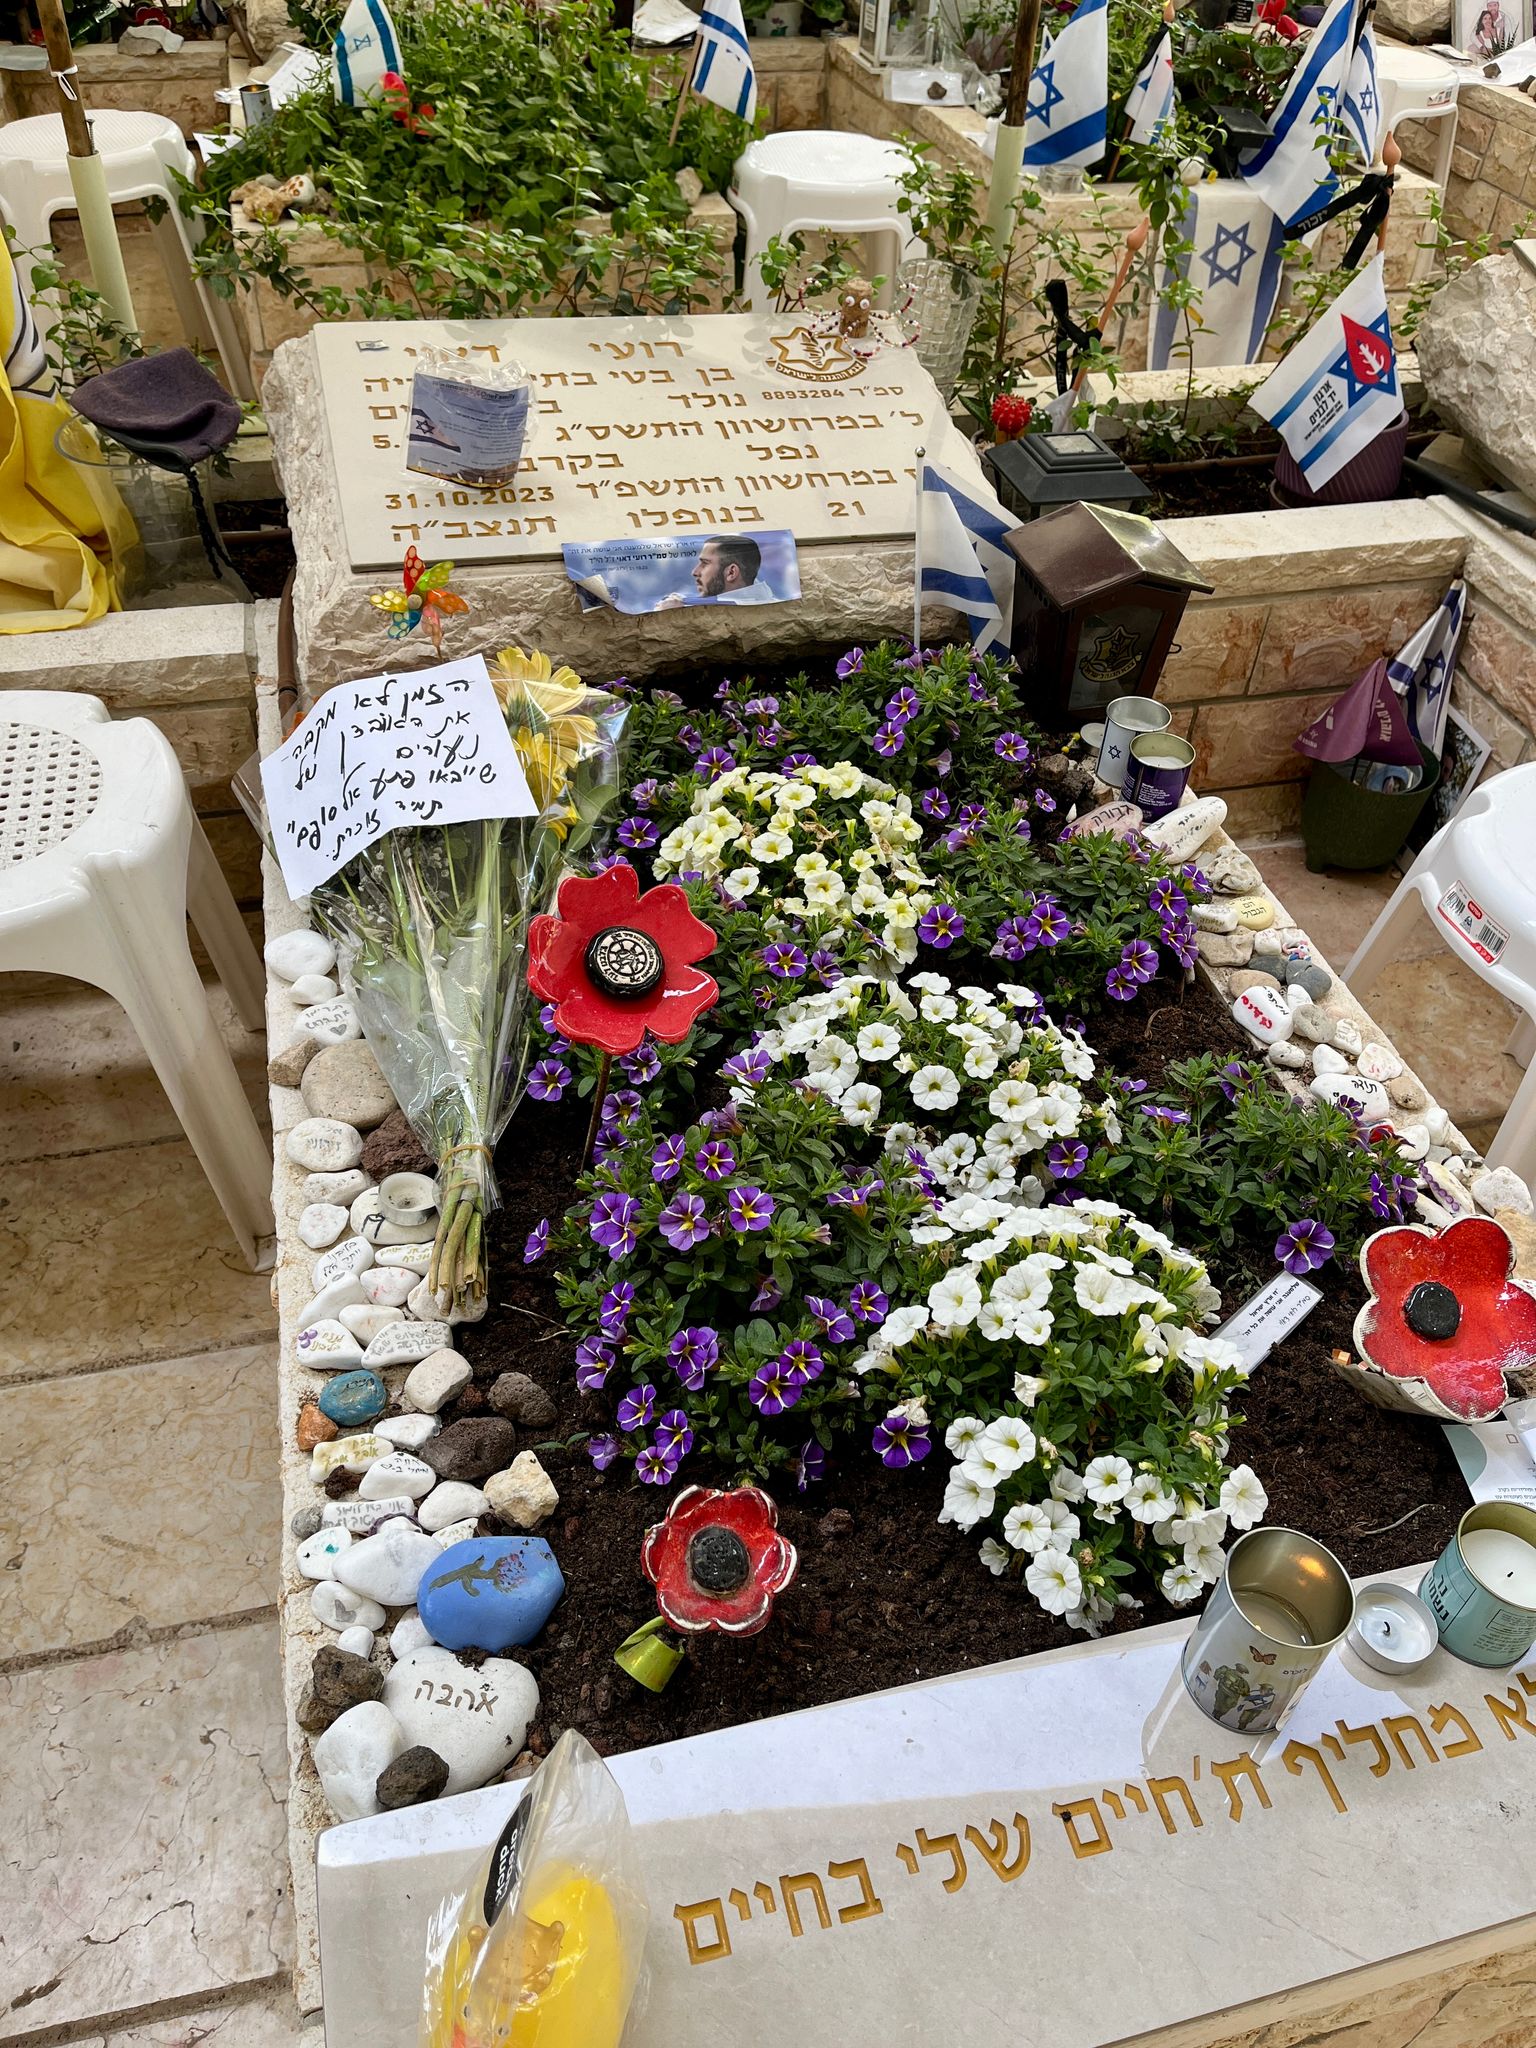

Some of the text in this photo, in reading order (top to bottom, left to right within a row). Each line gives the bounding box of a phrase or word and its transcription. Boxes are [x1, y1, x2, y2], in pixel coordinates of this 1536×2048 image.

[1297, 209, 1328, 231] יזכור
[588, 341, 684, 360] רועי
[608, 369, 675, 385] בטי
[696, 368, 735, 386] בן
[668, 392, 747, 409] נולד
[761, 385, 904, 400] סמ"ר 8893284
[1313, 380, 1333, 404] ארגון
[1309, 390, 1336, 425] יד לבנים
[555, 421, 704, 442] התשס"ג
[715, 414, 884, 440] במרחשוון
[746, 444, 820, 461] נפל
[576, 476, 725, 499] התשפ"ד
[735, 469, 898, 497] במרחשוון
[385, 486, 555, 510] 31.10.2023
[391, 500, 866, 542] 21 בנופלו תנצב"ה
[668, 551, 679, 559] של
[353, 679, 397, 711] לא
[426, 711, 471, 738] את
[396, 734, 479, 768] נעורים
[369, 767, 416, 800] פתע
[395, 800, 443, 820] תמיד
[1090, 803, 1134, 827] גבורה
[1240, 906, 1267, 918] הגבול
[1351, 1079, 1378, 1093] תודה
[414, 1679, 500, 1717] אהבה
[1281, 1702, 1484, 1814] מחליף
[895, 1811, 1033, 1893] שלי
[672, 1856, 884, 1965] בחיים
